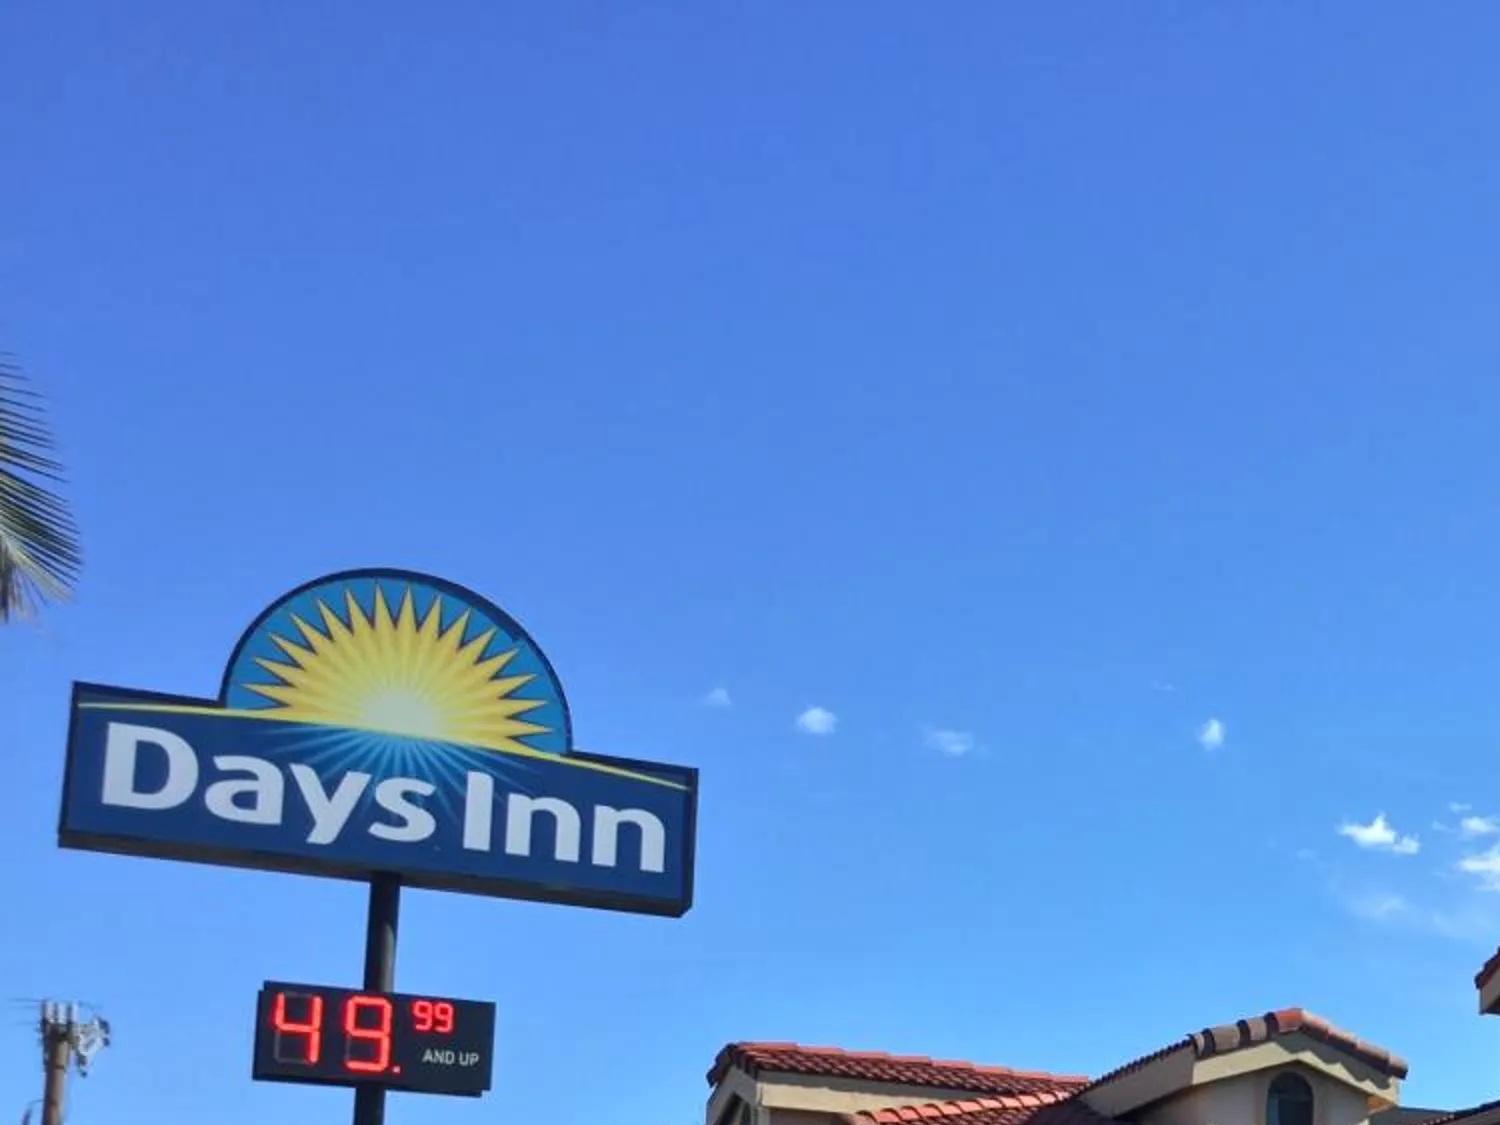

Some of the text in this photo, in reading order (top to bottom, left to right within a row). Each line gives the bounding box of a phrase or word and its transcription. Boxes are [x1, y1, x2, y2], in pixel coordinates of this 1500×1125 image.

[100, 722, 666, 874] Days Inn
[422, 1049, 480, 1067] AND UP
